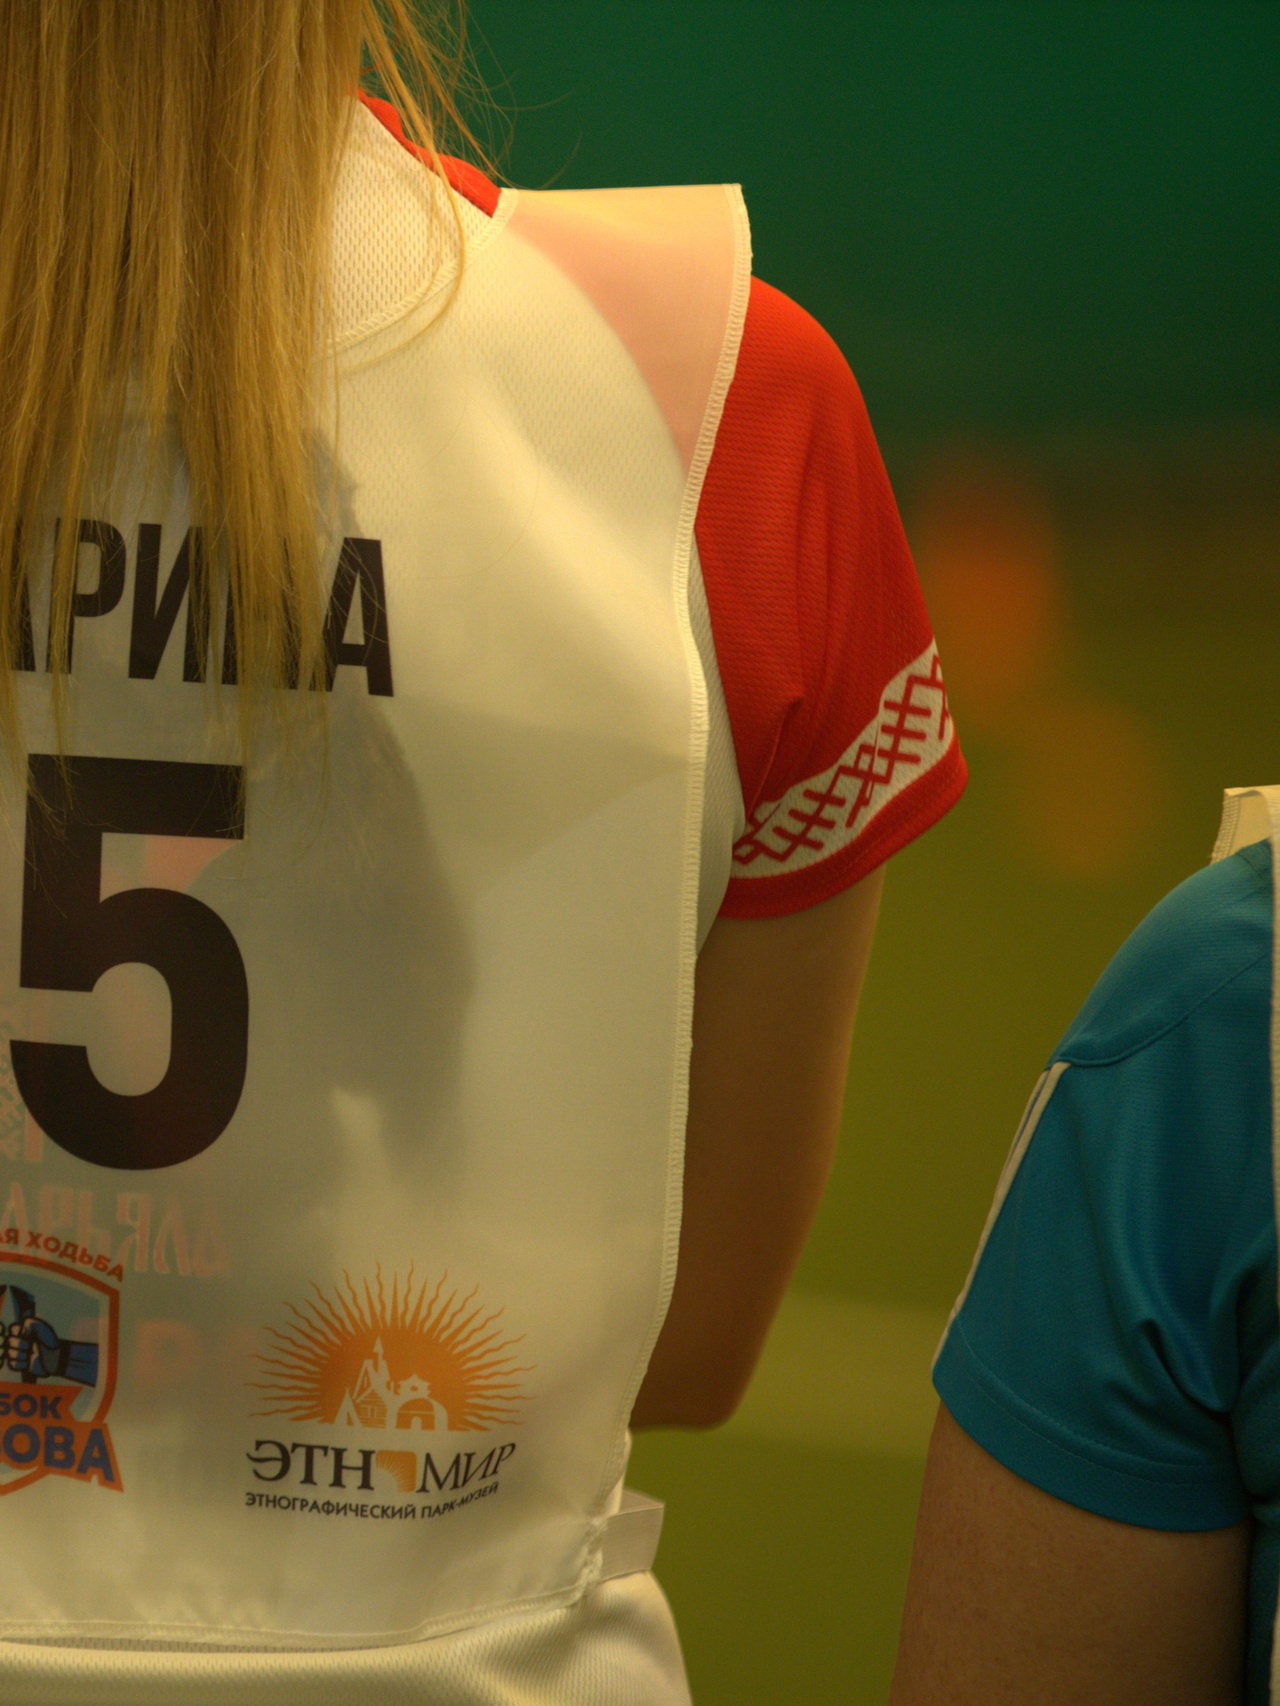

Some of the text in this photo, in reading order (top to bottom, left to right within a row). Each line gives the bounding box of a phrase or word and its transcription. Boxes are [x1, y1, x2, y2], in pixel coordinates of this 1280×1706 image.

[25, 1231, 124, 1283] ХОДЬБА
[245, 1481, 499, 1520] ЭТНОГРАФИЧЕСКИЙ ПАРК-МУЗЕЙ
